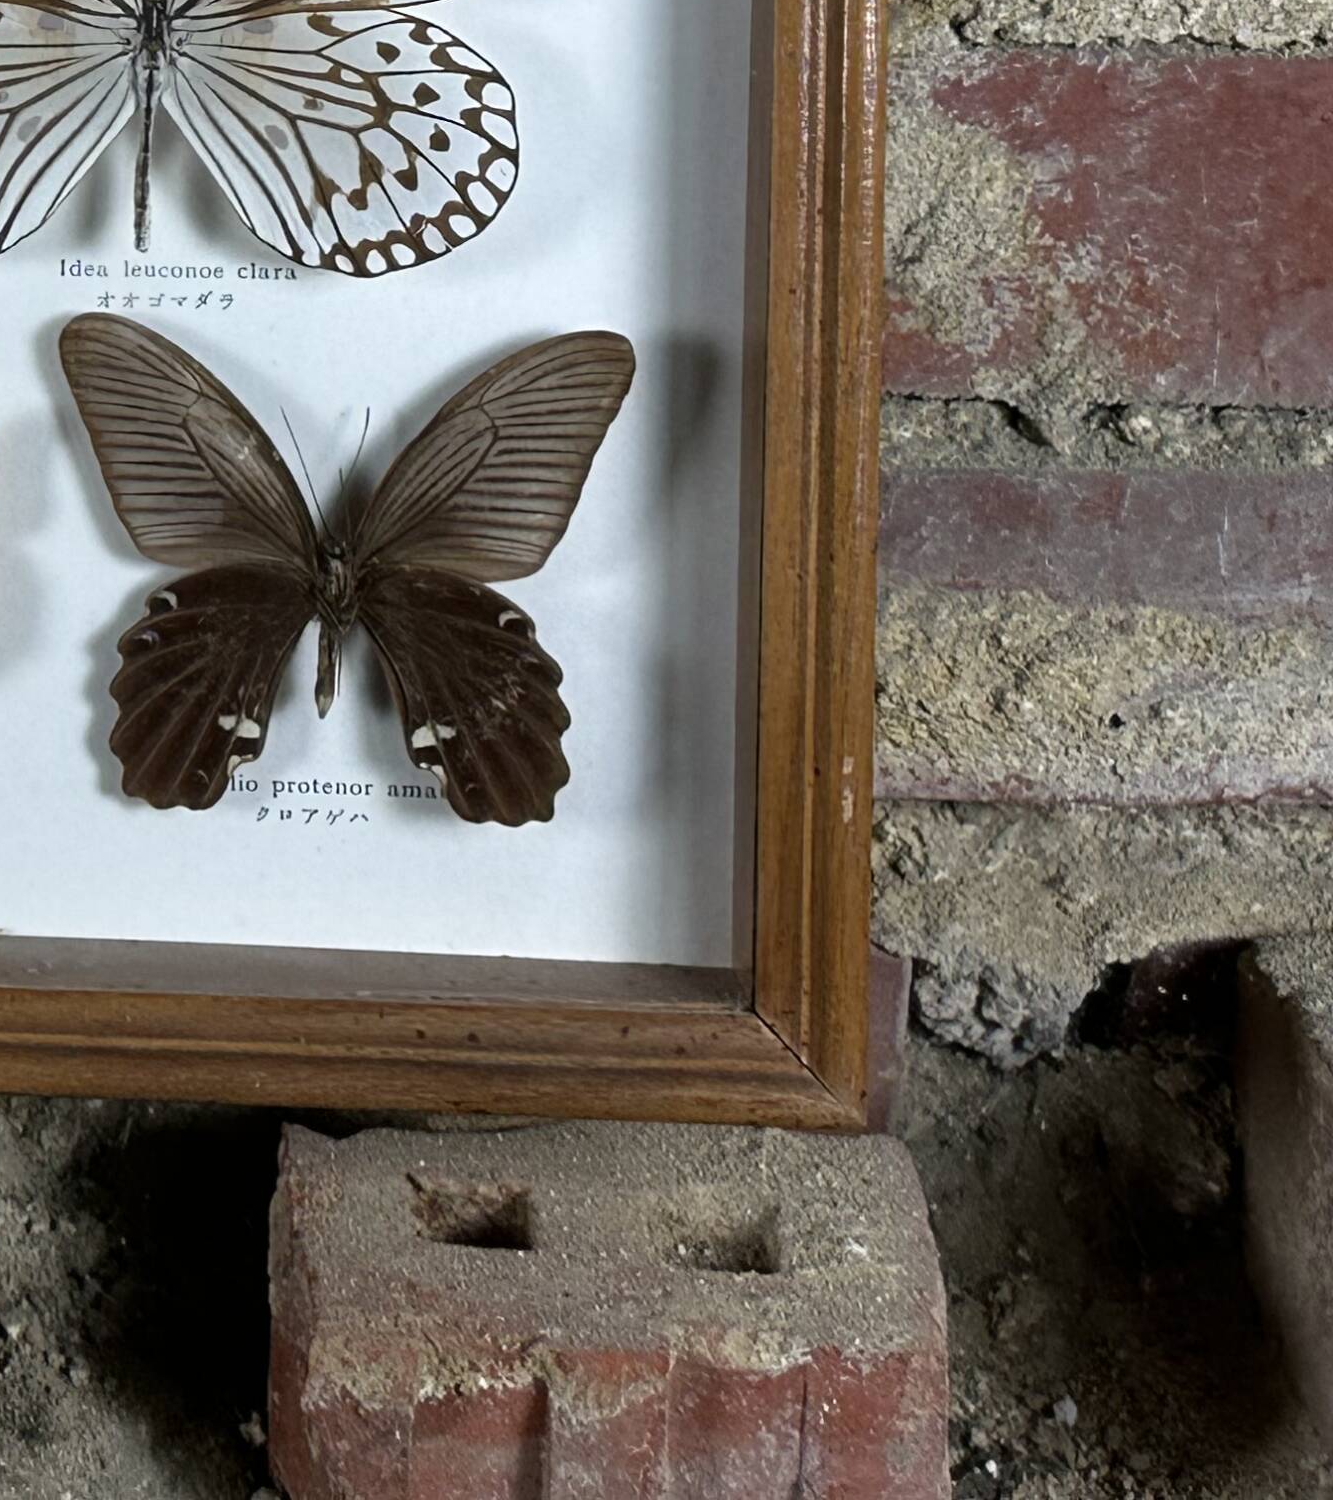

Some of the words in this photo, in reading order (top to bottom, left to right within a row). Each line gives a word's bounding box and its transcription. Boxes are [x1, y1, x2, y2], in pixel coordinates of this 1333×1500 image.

[60, 259, 109, 277] Idea
[123, 259, 225, 279] leuconoe
[237, 262, 298, 281] clara
[271, 778, 374, 799] protenor
